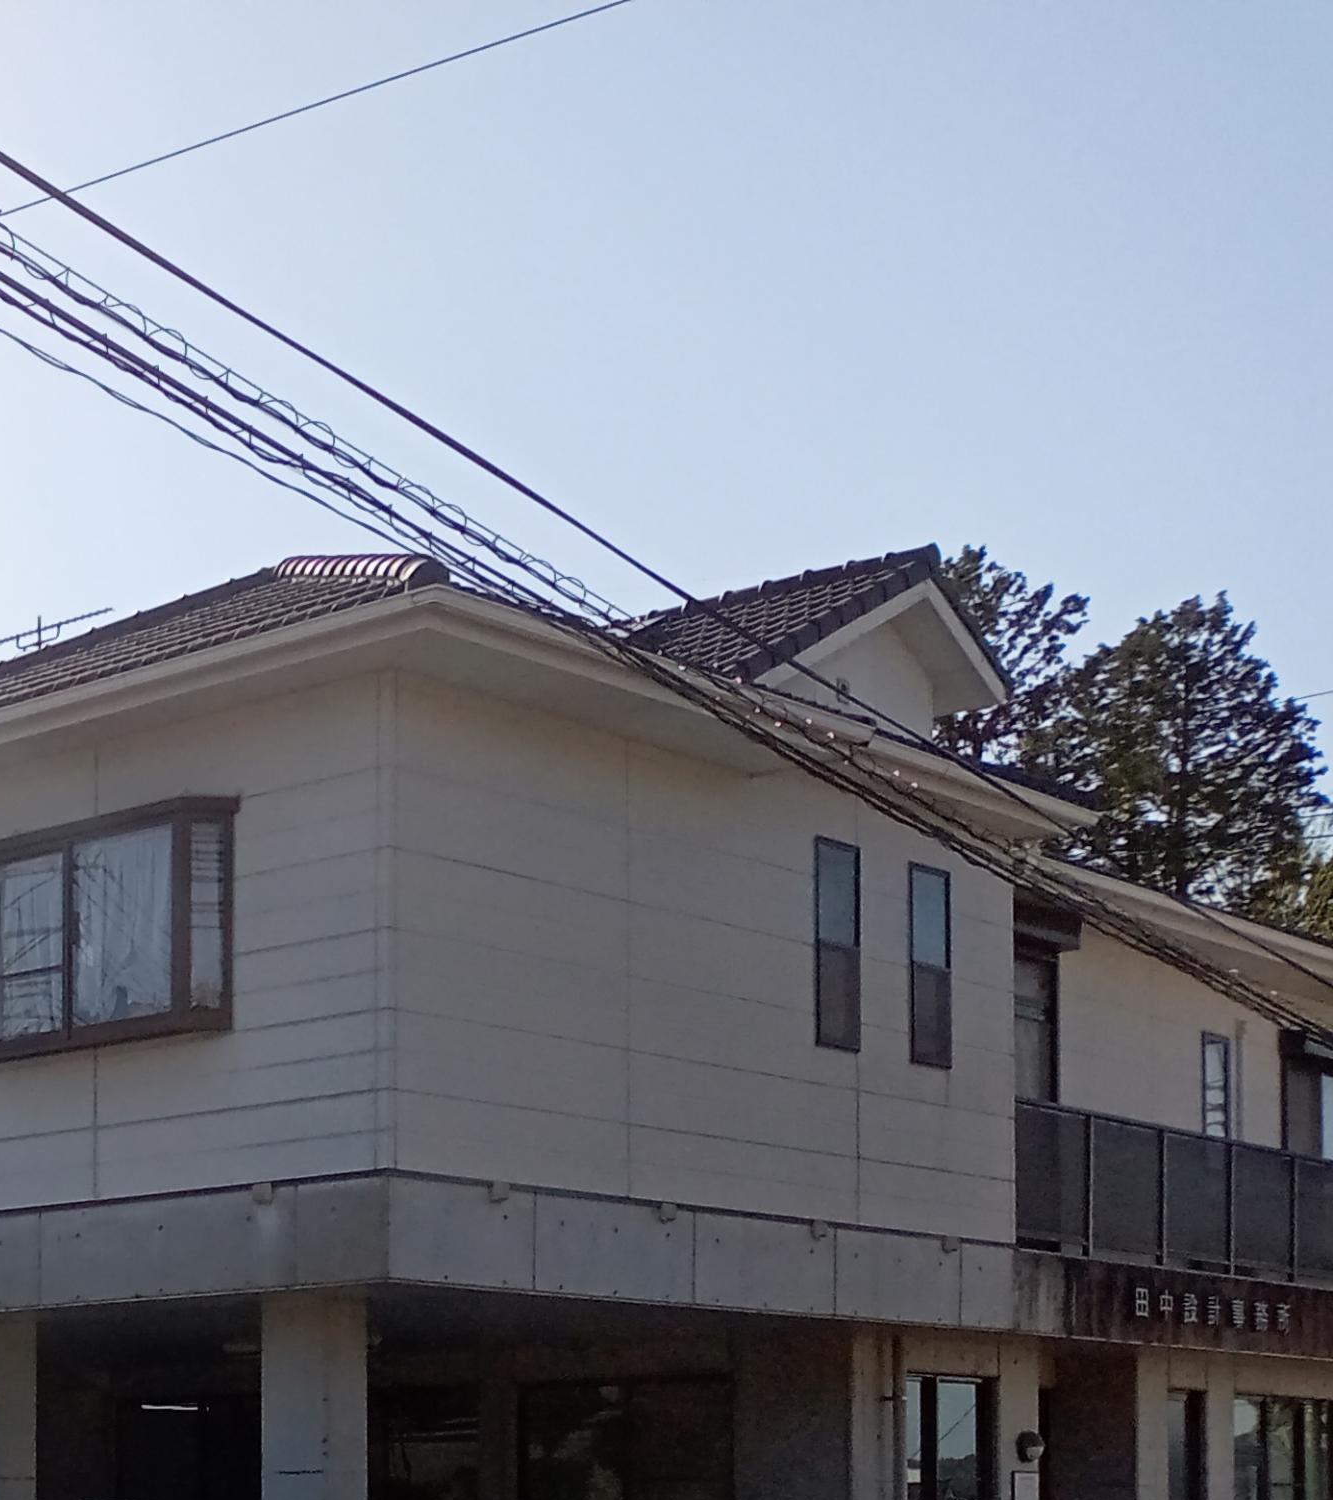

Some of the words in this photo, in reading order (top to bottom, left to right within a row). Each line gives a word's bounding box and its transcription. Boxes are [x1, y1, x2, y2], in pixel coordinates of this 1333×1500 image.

[1135, 1287, 1292, 1336] 田中設計事務所
